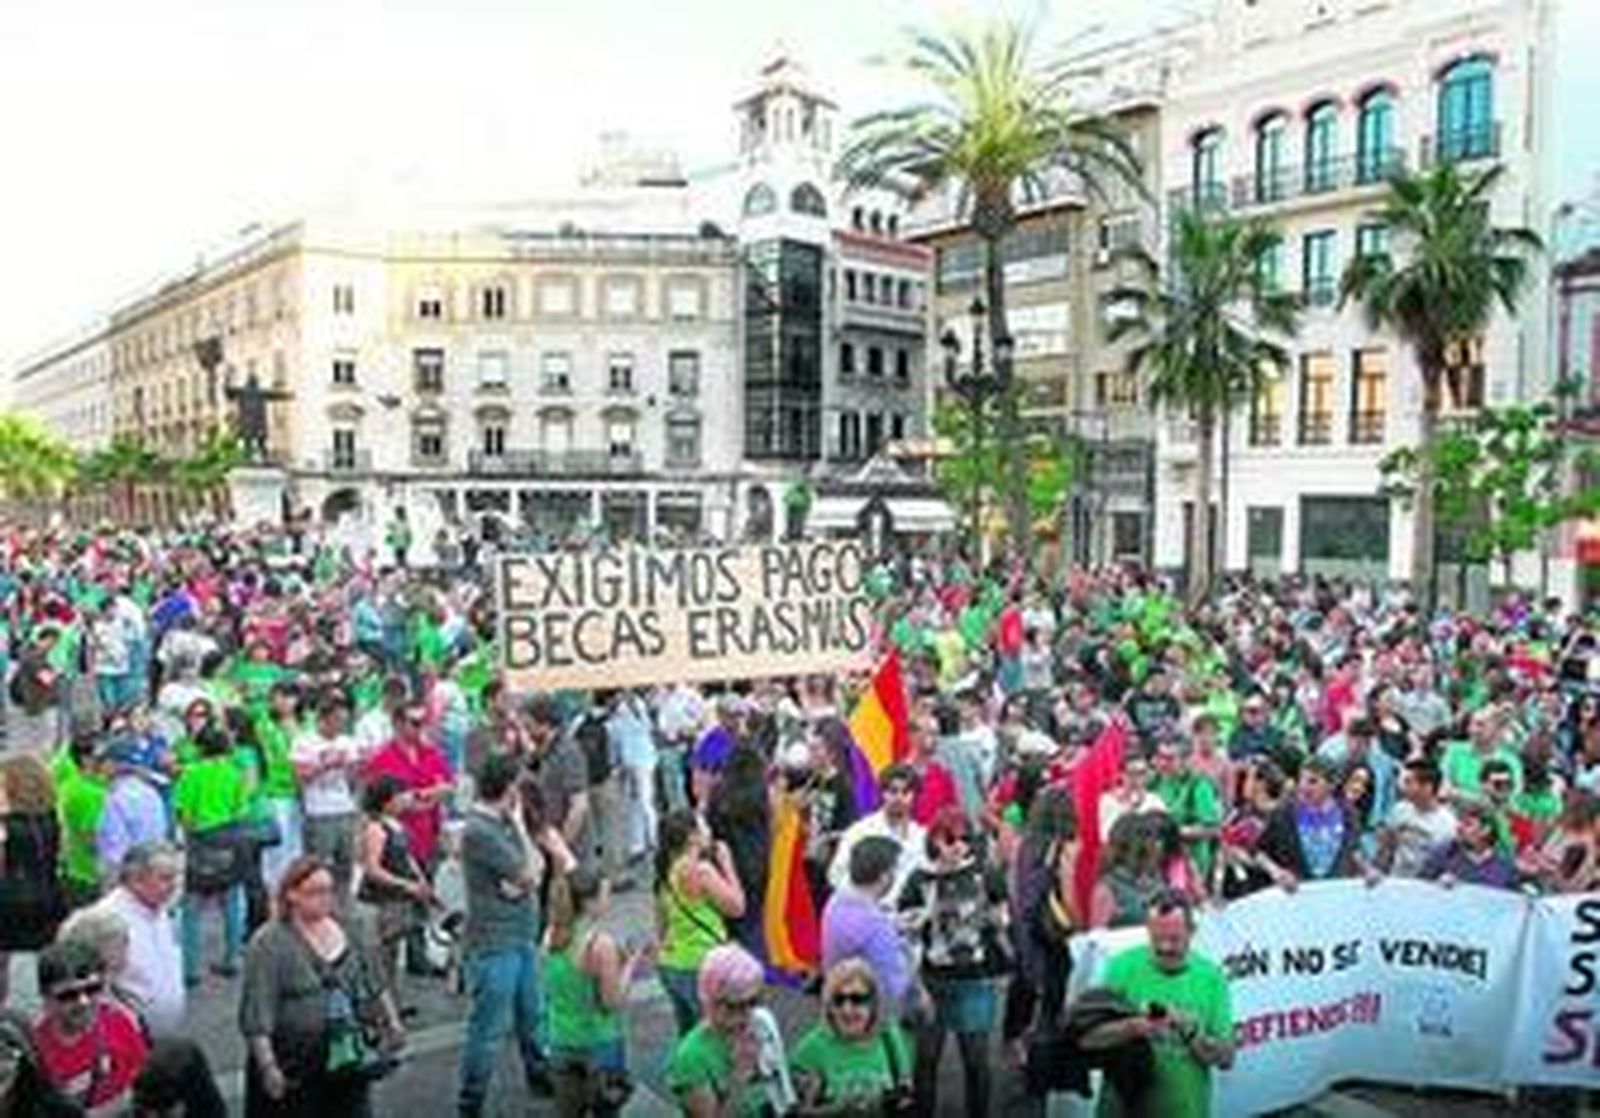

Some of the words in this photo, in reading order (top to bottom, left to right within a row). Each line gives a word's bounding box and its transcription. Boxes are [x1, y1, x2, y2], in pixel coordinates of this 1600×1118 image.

[501, 548, 743, 610] EXIGIMOS
[761, 542, 861, 598] PAGO
[504, 610, 666, 668] BECAS
[688, 596, 868, 659] ERASMUS
[1283, 947, 1325, 976] NO
